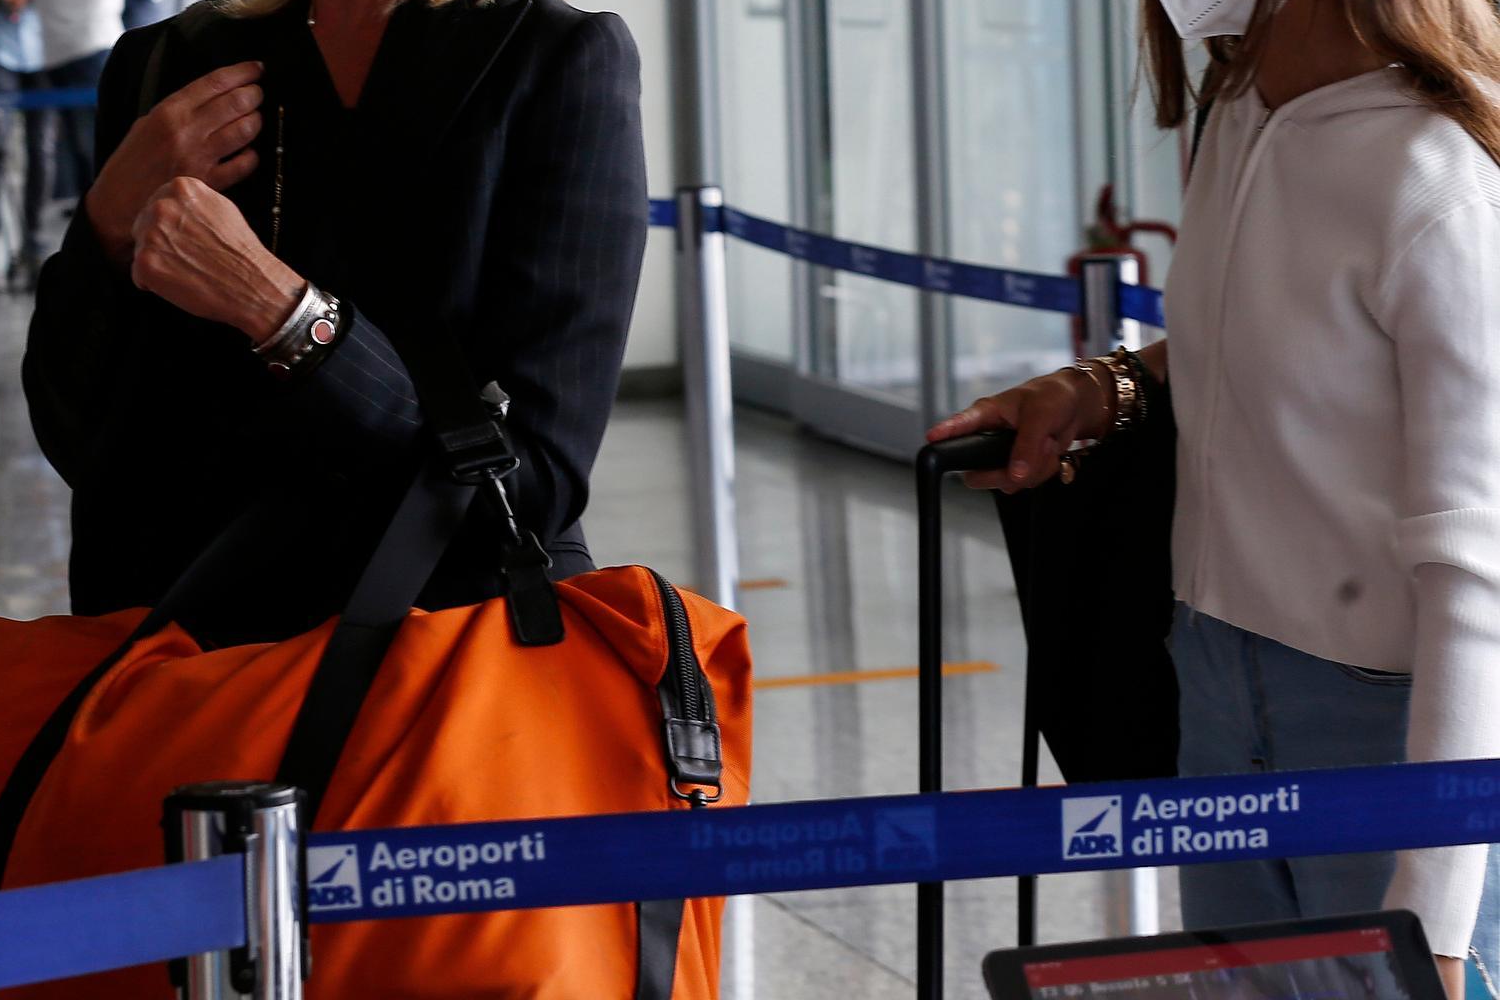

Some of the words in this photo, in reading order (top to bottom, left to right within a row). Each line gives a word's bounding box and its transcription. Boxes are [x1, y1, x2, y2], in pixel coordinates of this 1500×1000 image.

[1132, 784, 1300, 822] Aeroporti
[368, 832, 546, 872] Aeroporti
[1067, 833, 1119, 857] ADR
[1132, 828, 1164, 856] di
[1171, 825, 1269, 854] Roma
[371, 877, 405, 908] di
[412, 875, 515, 904] Roma
